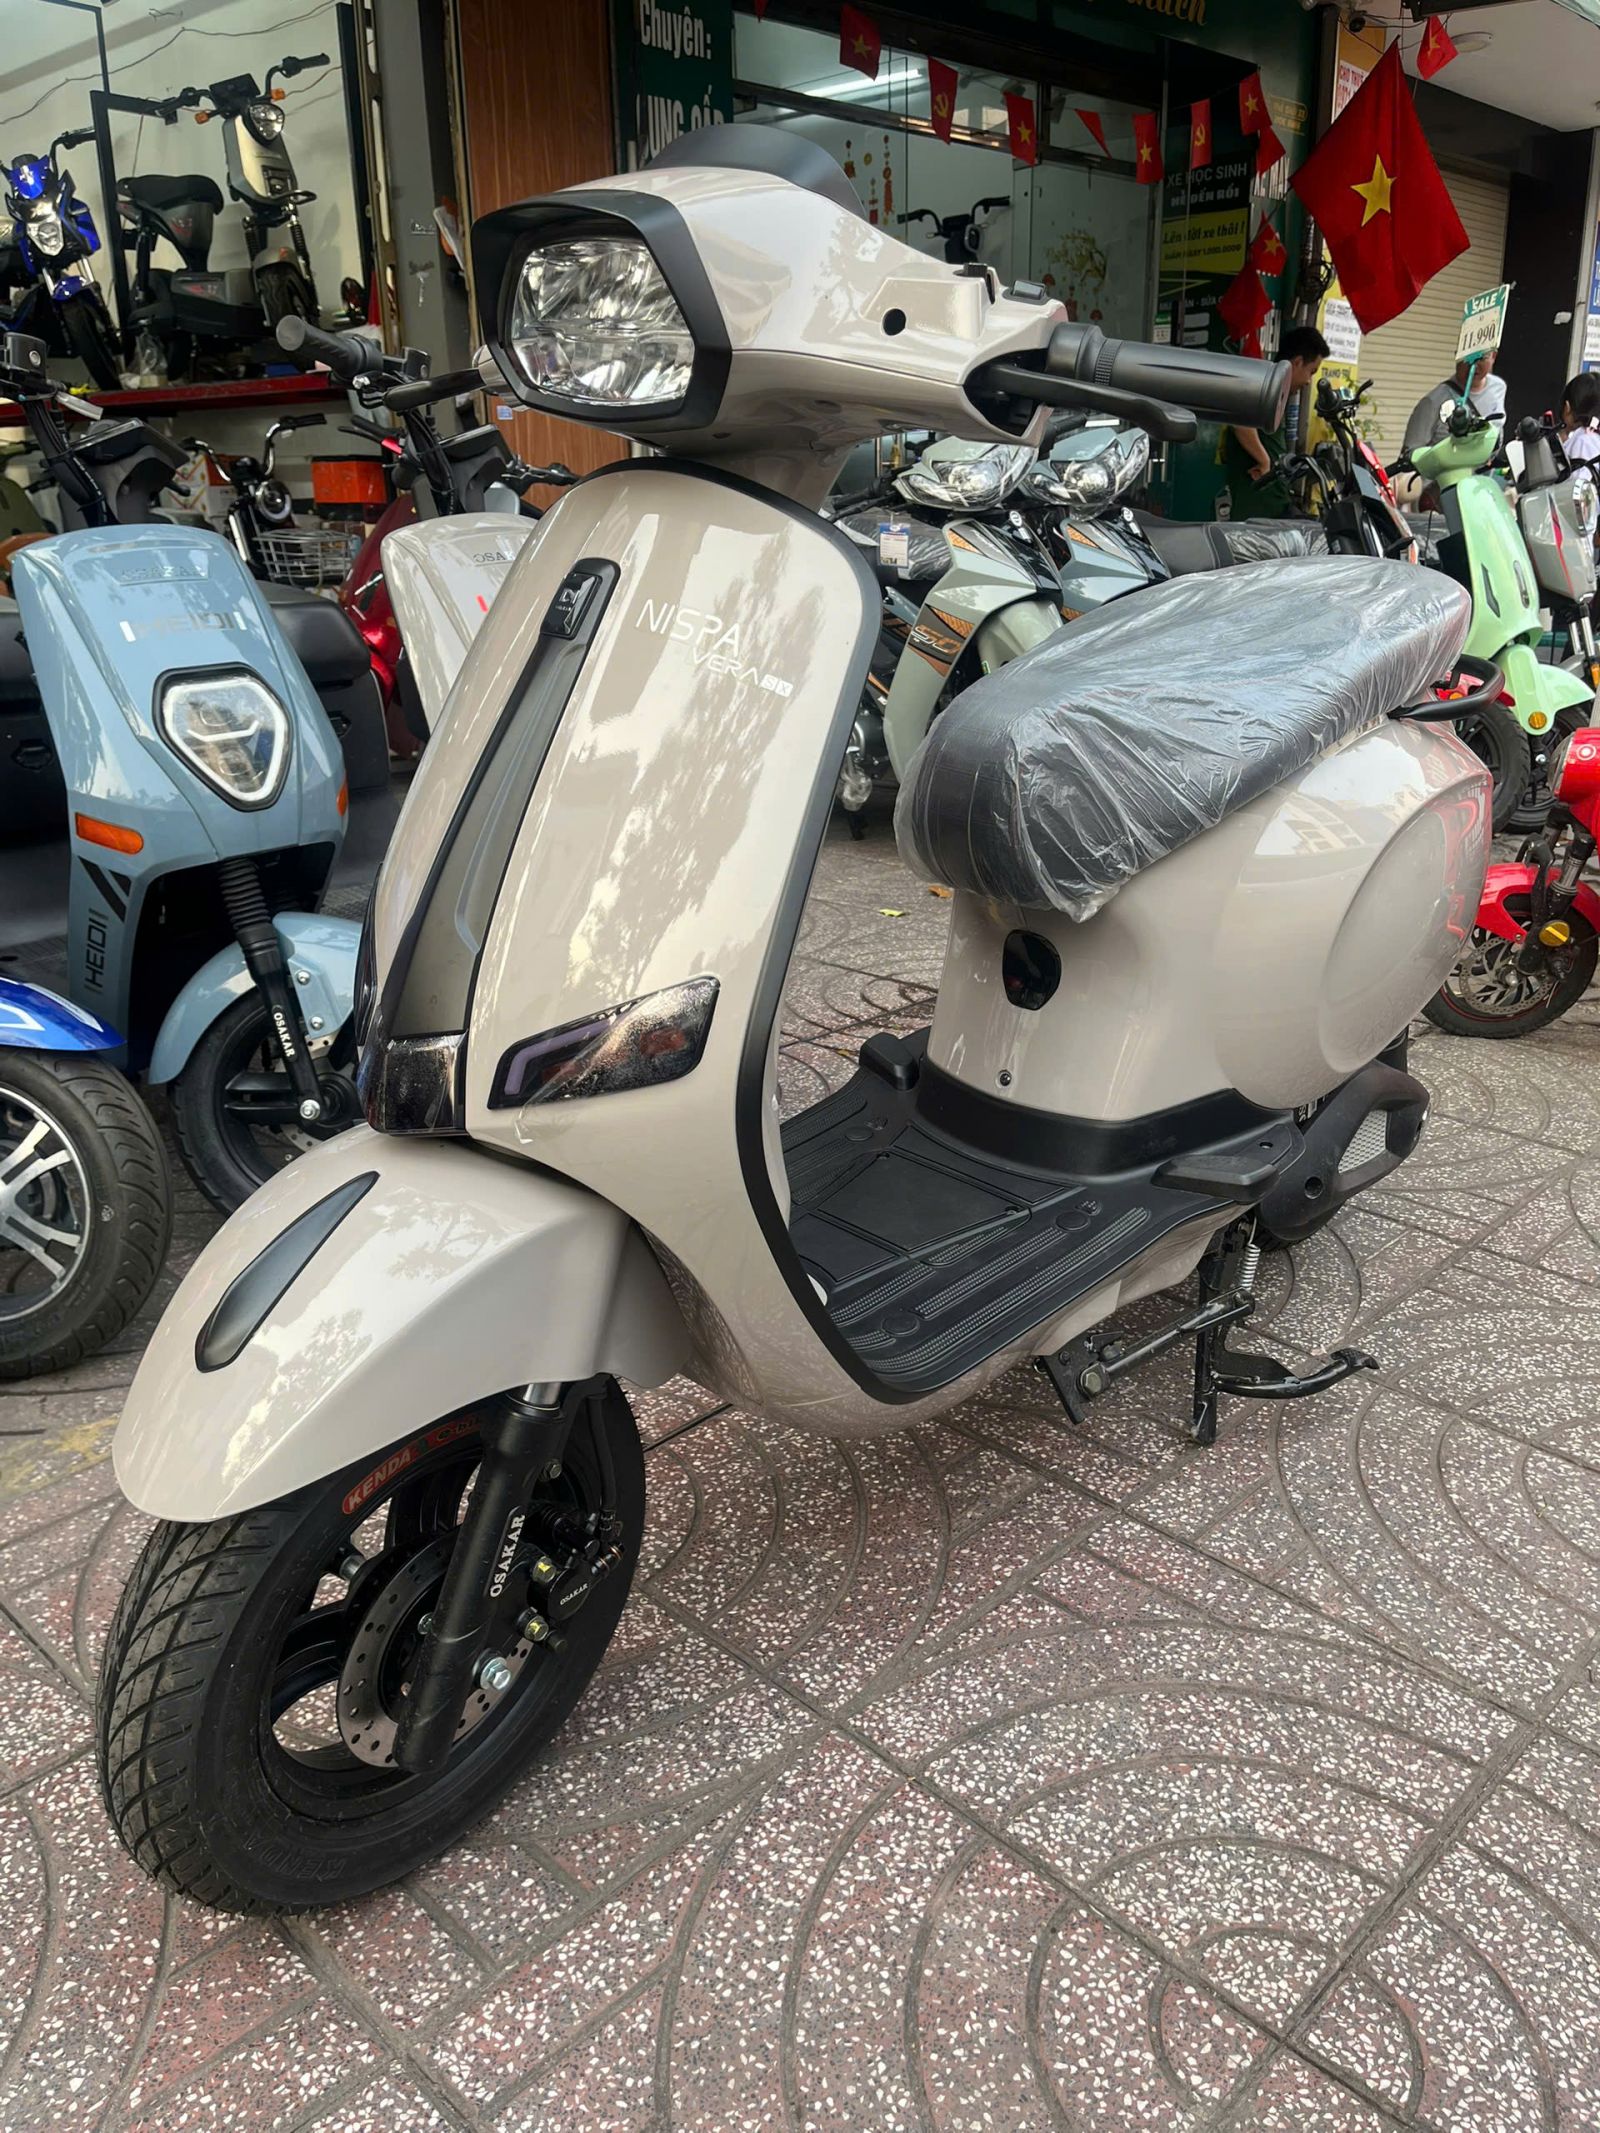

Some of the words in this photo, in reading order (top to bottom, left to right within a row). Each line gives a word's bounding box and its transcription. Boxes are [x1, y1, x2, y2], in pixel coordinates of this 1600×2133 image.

[640, 0, 711, 59] Chuyên:
[1167, 172, 1183, 187] XE
[1215, 162, 1248, 181] SINH
[1202, 228, 1215, 238] xe
[1216, 222, 1239, 237] thôi
[1471, 292, 1498, 314] SALE
[1462, 323, 1496, 351] 11.990
[473, 551, 516, 563] OSAK
[635, 598, 740, 657] NISPA
[692, 647, 761, 685] VERA
[273, 1012, 296, 1058] OSAKAR
[347, 1446, 412, 1511] KENDA
[489, 1514, 526, 1598] OSAKAR
[559, 1583, 589, 1606] OSAKAR
